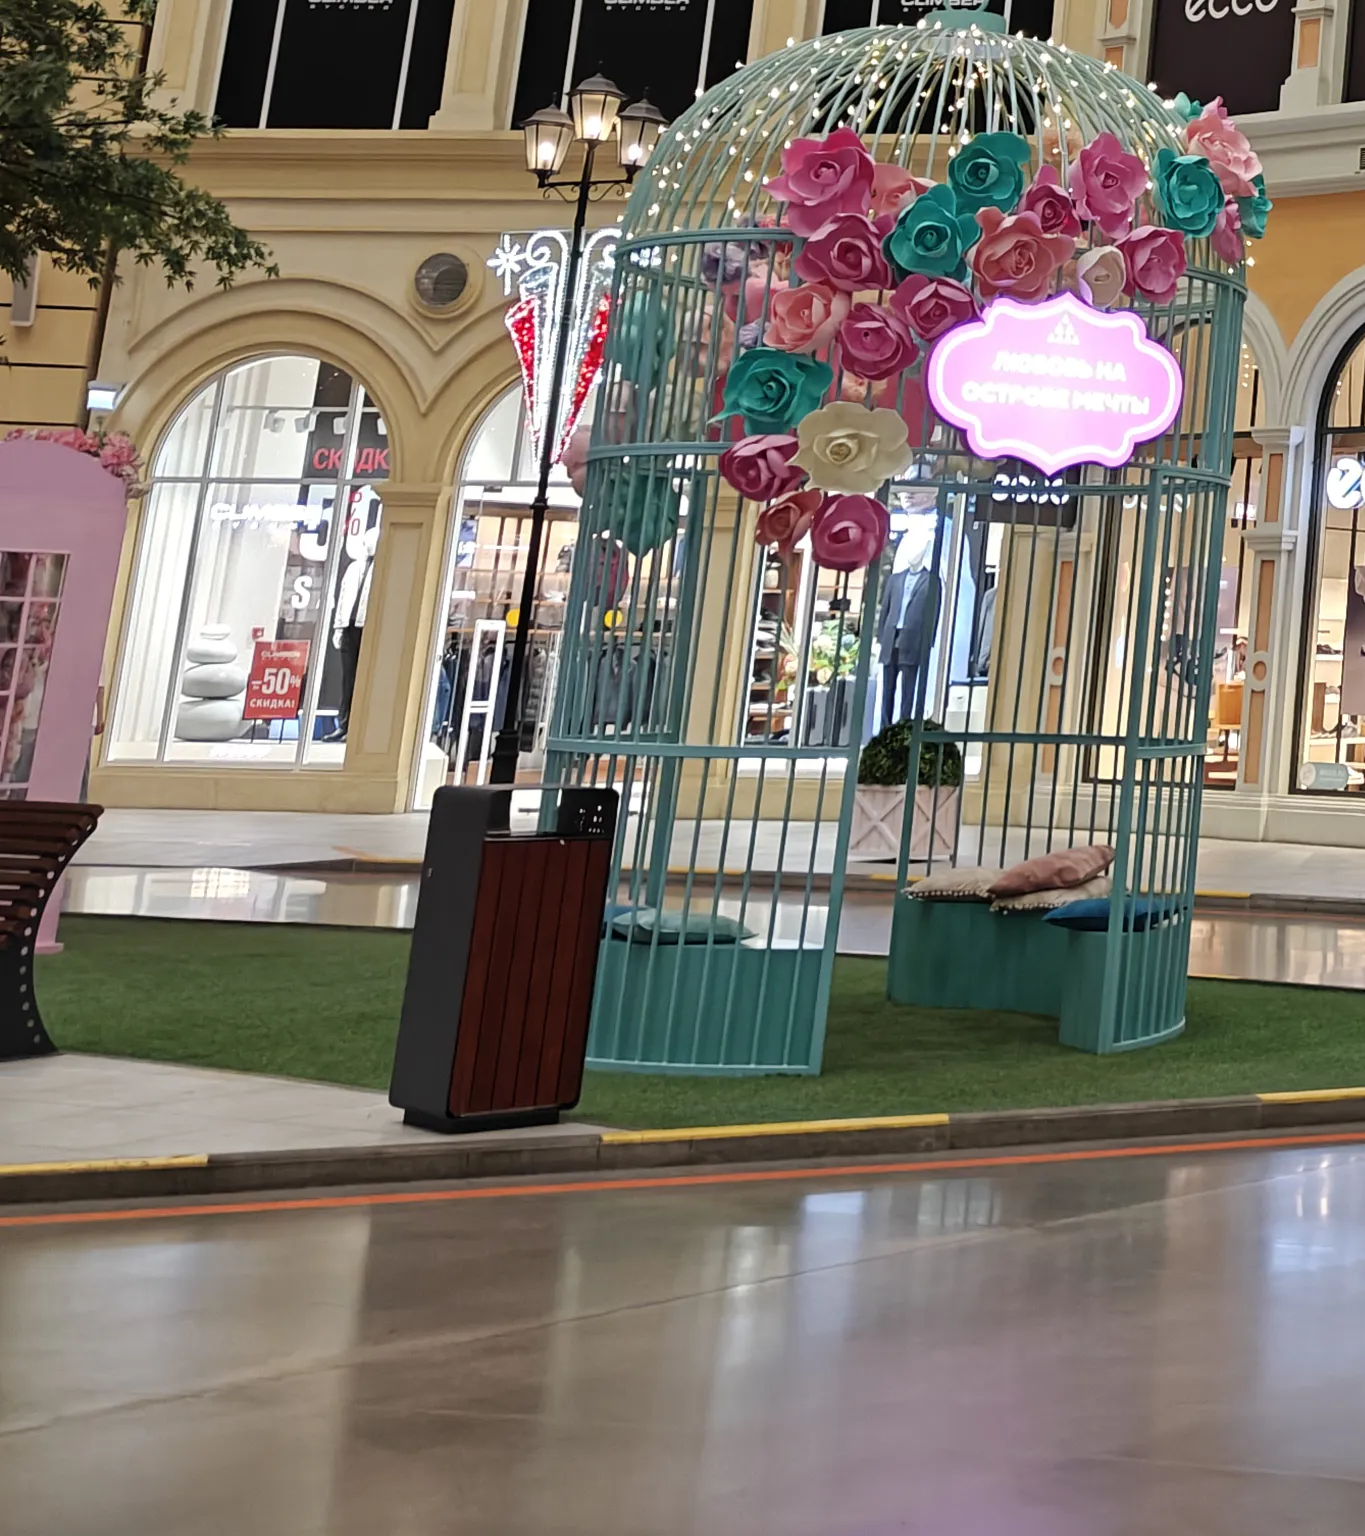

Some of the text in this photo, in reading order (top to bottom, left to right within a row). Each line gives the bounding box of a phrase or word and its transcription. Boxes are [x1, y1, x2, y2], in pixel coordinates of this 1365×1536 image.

[1095, 359, 1127, 382] НА
[1071, 390, 1151, 415] МЕЧТЫ
[249, 698, 296, 710] СКИДКА!
